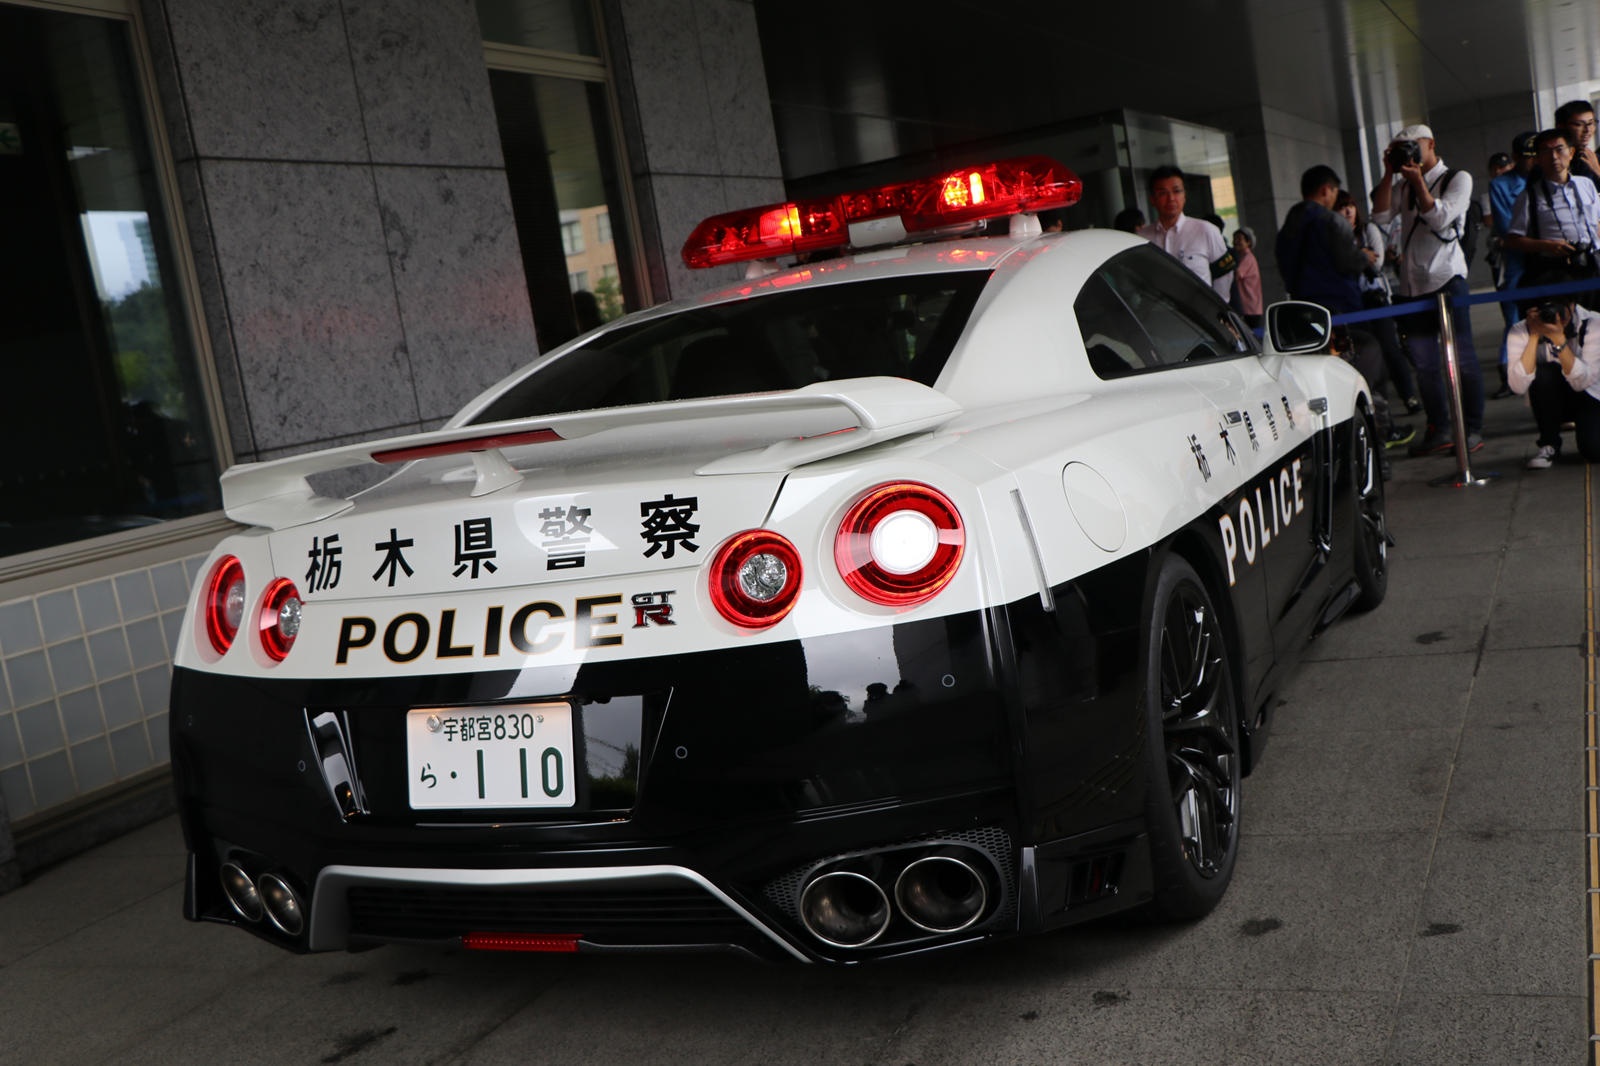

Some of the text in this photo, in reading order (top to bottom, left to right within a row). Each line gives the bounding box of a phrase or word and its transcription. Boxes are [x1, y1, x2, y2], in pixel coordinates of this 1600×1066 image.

[305, 494, 701, 593] 栃木県警察
[1219, 458, 1304, 587] POLICE
[335, 593, 624, 665] POLICE
